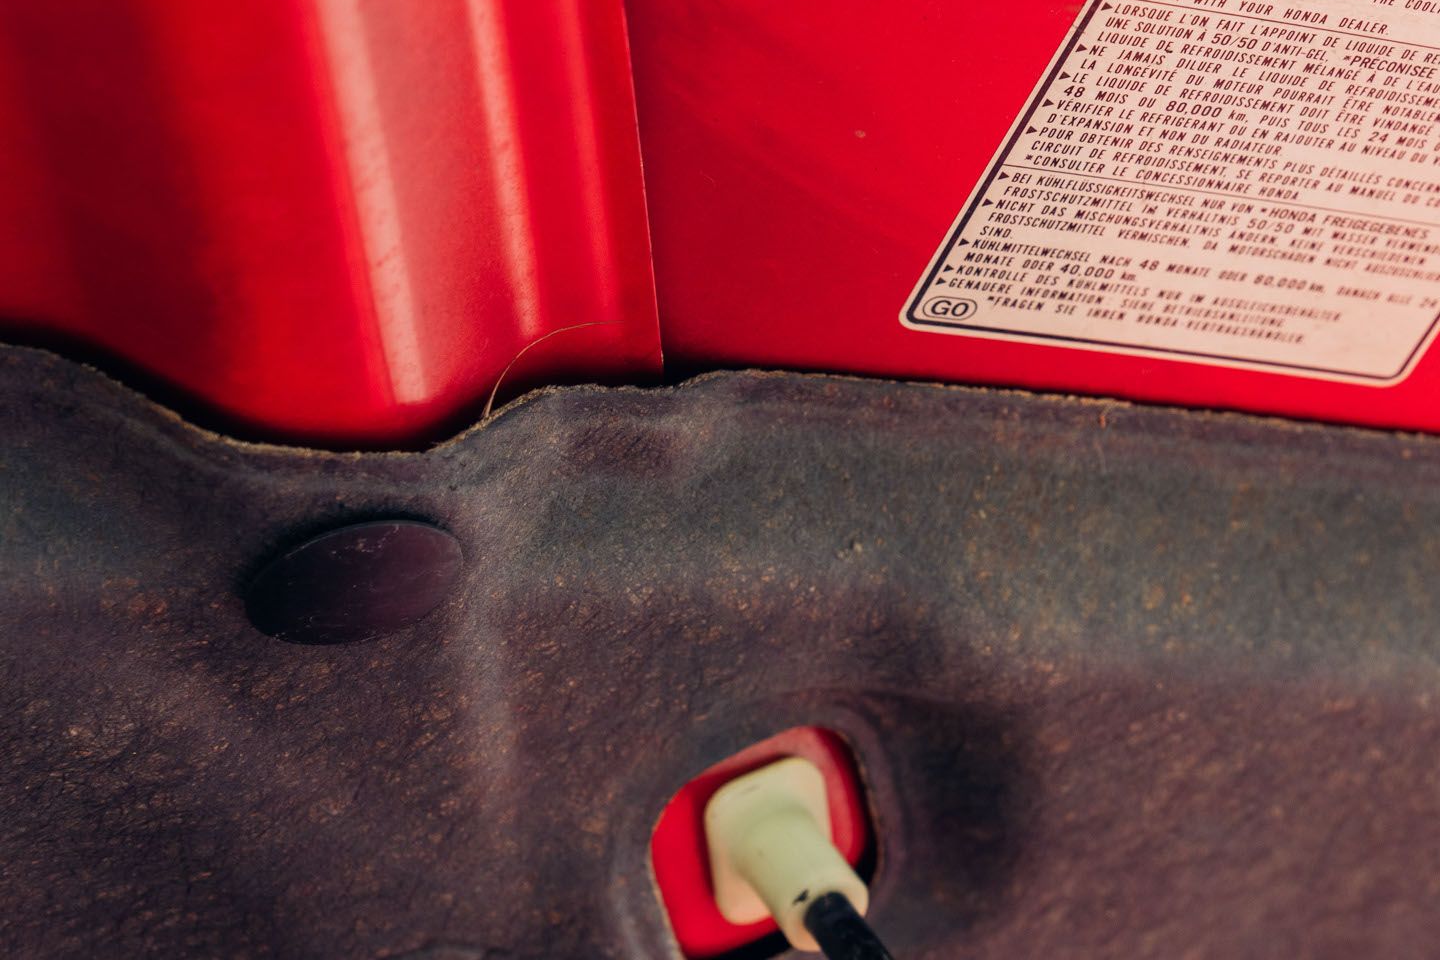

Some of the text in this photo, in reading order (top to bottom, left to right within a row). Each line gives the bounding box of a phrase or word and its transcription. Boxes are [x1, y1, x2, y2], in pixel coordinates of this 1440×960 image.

[1104, 15, 1131, 30] UNE
[1133, 20, 1194, 40] SOLUTION
[1210, 32, 1259, 50] 50/50
[1113, 2, 1174, 22] LORSQUE
[1177, 12, 1210, 27] L'ON
[1215, 18, 1245, 32] FAIT
[1249, 23, 1317, 44] L'APPOINT
[1344, 39, 1395, 57] LIQUIDE
[1237, 0, 1274, 16] YOUR
[1282, 7, 1328, 25] HONDA
[1337, 16, 1388, 36] DEALER.
[1087, 44, 1309, 87] NE JAMAIS DILUER LE LIQUIDE
[1096, 30, 1297, 70] LIQUIDE REFROIDISSEMENT
[1070, 71, 1330, 119] LE LIQUIDE REFROIDISSEMENT DOIT
[1079, 57, 1097, 70] LA
[1105, 61, 1177, 82] LONGÉVITÉ
[1212, 77, 1264, 95] MOTEUR
[1271, 86, 1336, 106] POURRAIT
[1045, 112, 1187, 142] D'EXPANSION NON
[1055, 96, 1114, 117] VÉRIFIER
[1250, 127, 1269, 139] EN
[1272, 130, 1335, 149] RAJOUTER
[1062, 84, 1389, 143] 48 MOIS 80,000 PUIS TOUS LES 24
[1030, 139, 1321, 189] CIRCUIT REPORTER
[1037, 125, 1316, 175] POUR OBTENIR DES RENSEIGNEMENTS PLUS
[1010, 171, 1033, 184] BEI
[1199, 197, 1226, 210] NUR
[1111, 164, 1299, 200] LE CONCESSIONNAIRE HONDA
[987, 211, 1106, 237] FROSTSCHUTZMITTEL
[994, 198, 1067, 217] NICHT DAS
[1002, 184, 1295, 234] FROSTSCHUTZMITTEL 50/50
[955, 264, 1060, 286] KONTROLLE DES
[962, 251, 1115, 279] MONATE ODER 40,000
[1138, 258, 1160, 271] 48
[930, 299, 969, 316] GO
[947, 277, 1104, 304] GENAUERE INFORMATION
